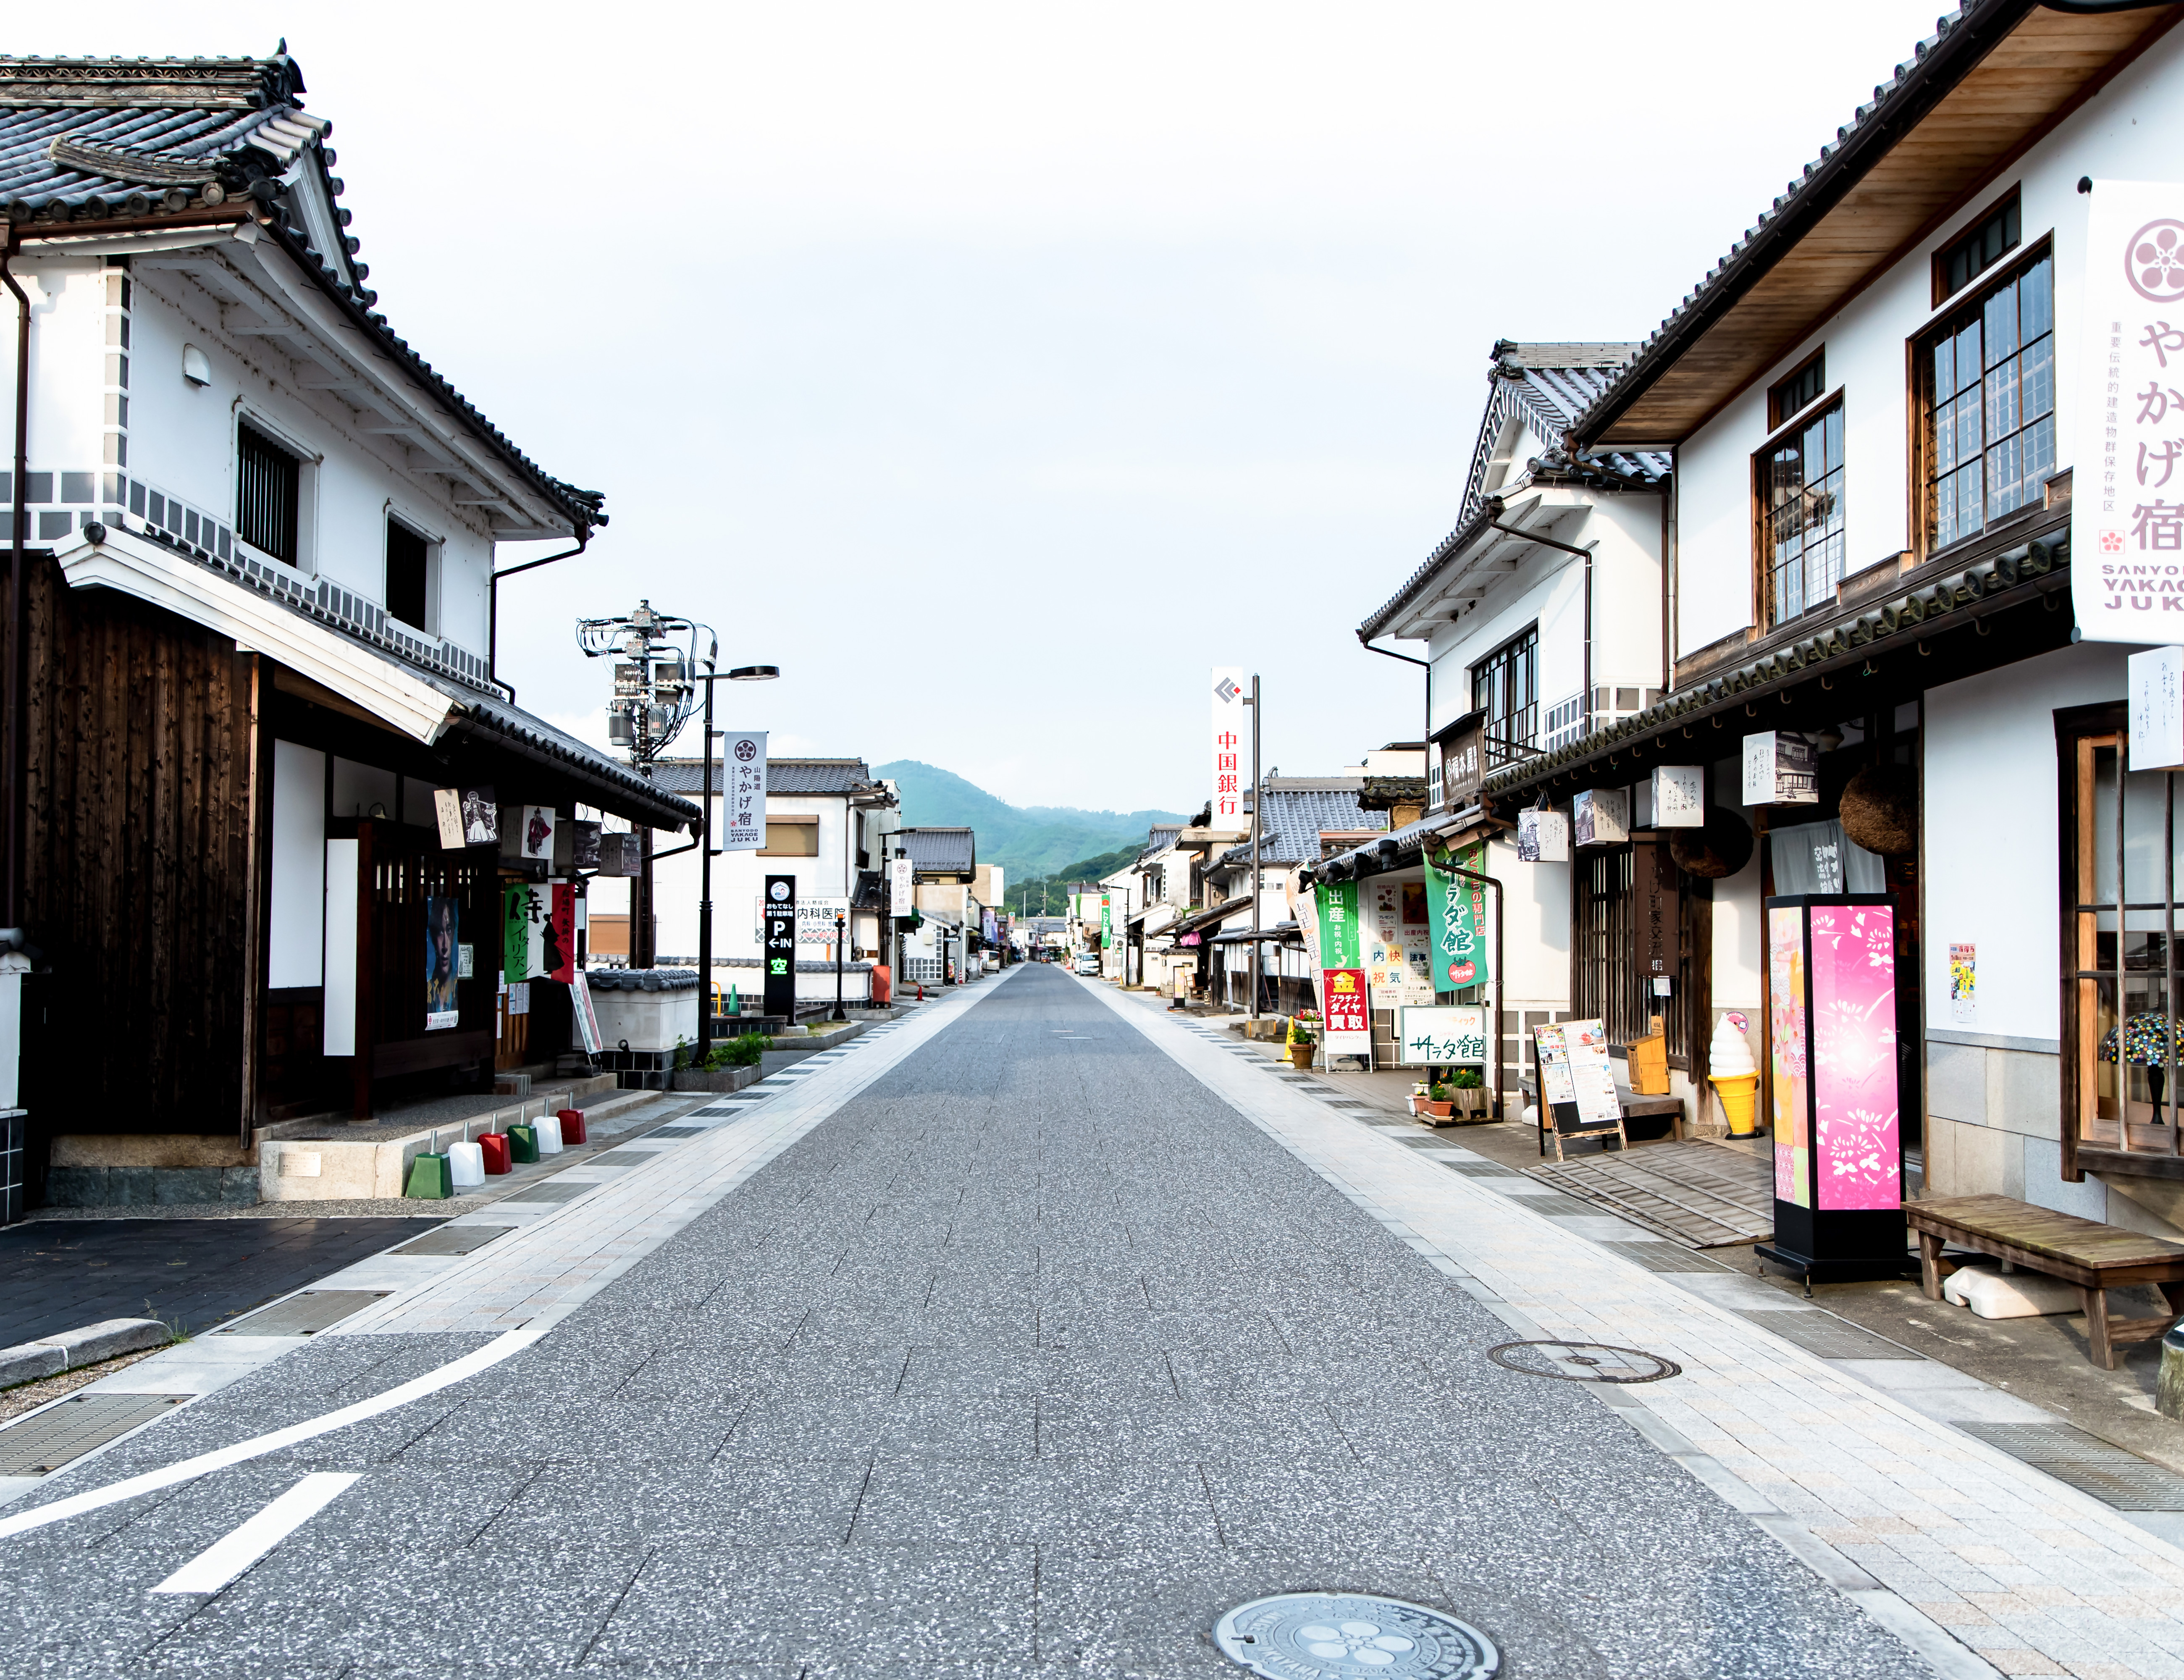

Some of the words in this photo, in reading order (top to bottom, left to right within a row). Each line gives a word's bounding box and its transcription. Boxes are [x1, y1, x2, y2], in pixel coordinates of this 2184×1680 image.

[2103, 321, 2123, 511] 重要伝統的建造物群保存地区
[2131, 320, 2184, 550] やかげ宿
[2102, 565, 2184, 575] SANYO
[1218, 731, 1237, 814] 中国銀行
[738, 766, 752, 826] やかげ宿
[509, 888, 543, 924] 侍
[798, 908, 845, 919] 内科医院
[1328, 889, 1346, 922] 出産
[774, 921, 785, 936] P
[1334, 924, 1343, 955] お祝・内祝
[512, 925, 533, 976] イタリアン
[780, 938, 792, 948] IN
[771, 958, 787, 974] 空
[1332, 971, 1356, 993] 金
[1330, 994, 1360, 1003] プラチナ
[1331, 1003, 1361, 1013] ダイヤ
[1330, 1015, 1364, 1030] 買取
[1410, 1034, 1483, 1060] サラダ館
[1257, 1646, 1322, 1677] OKAYAMA
